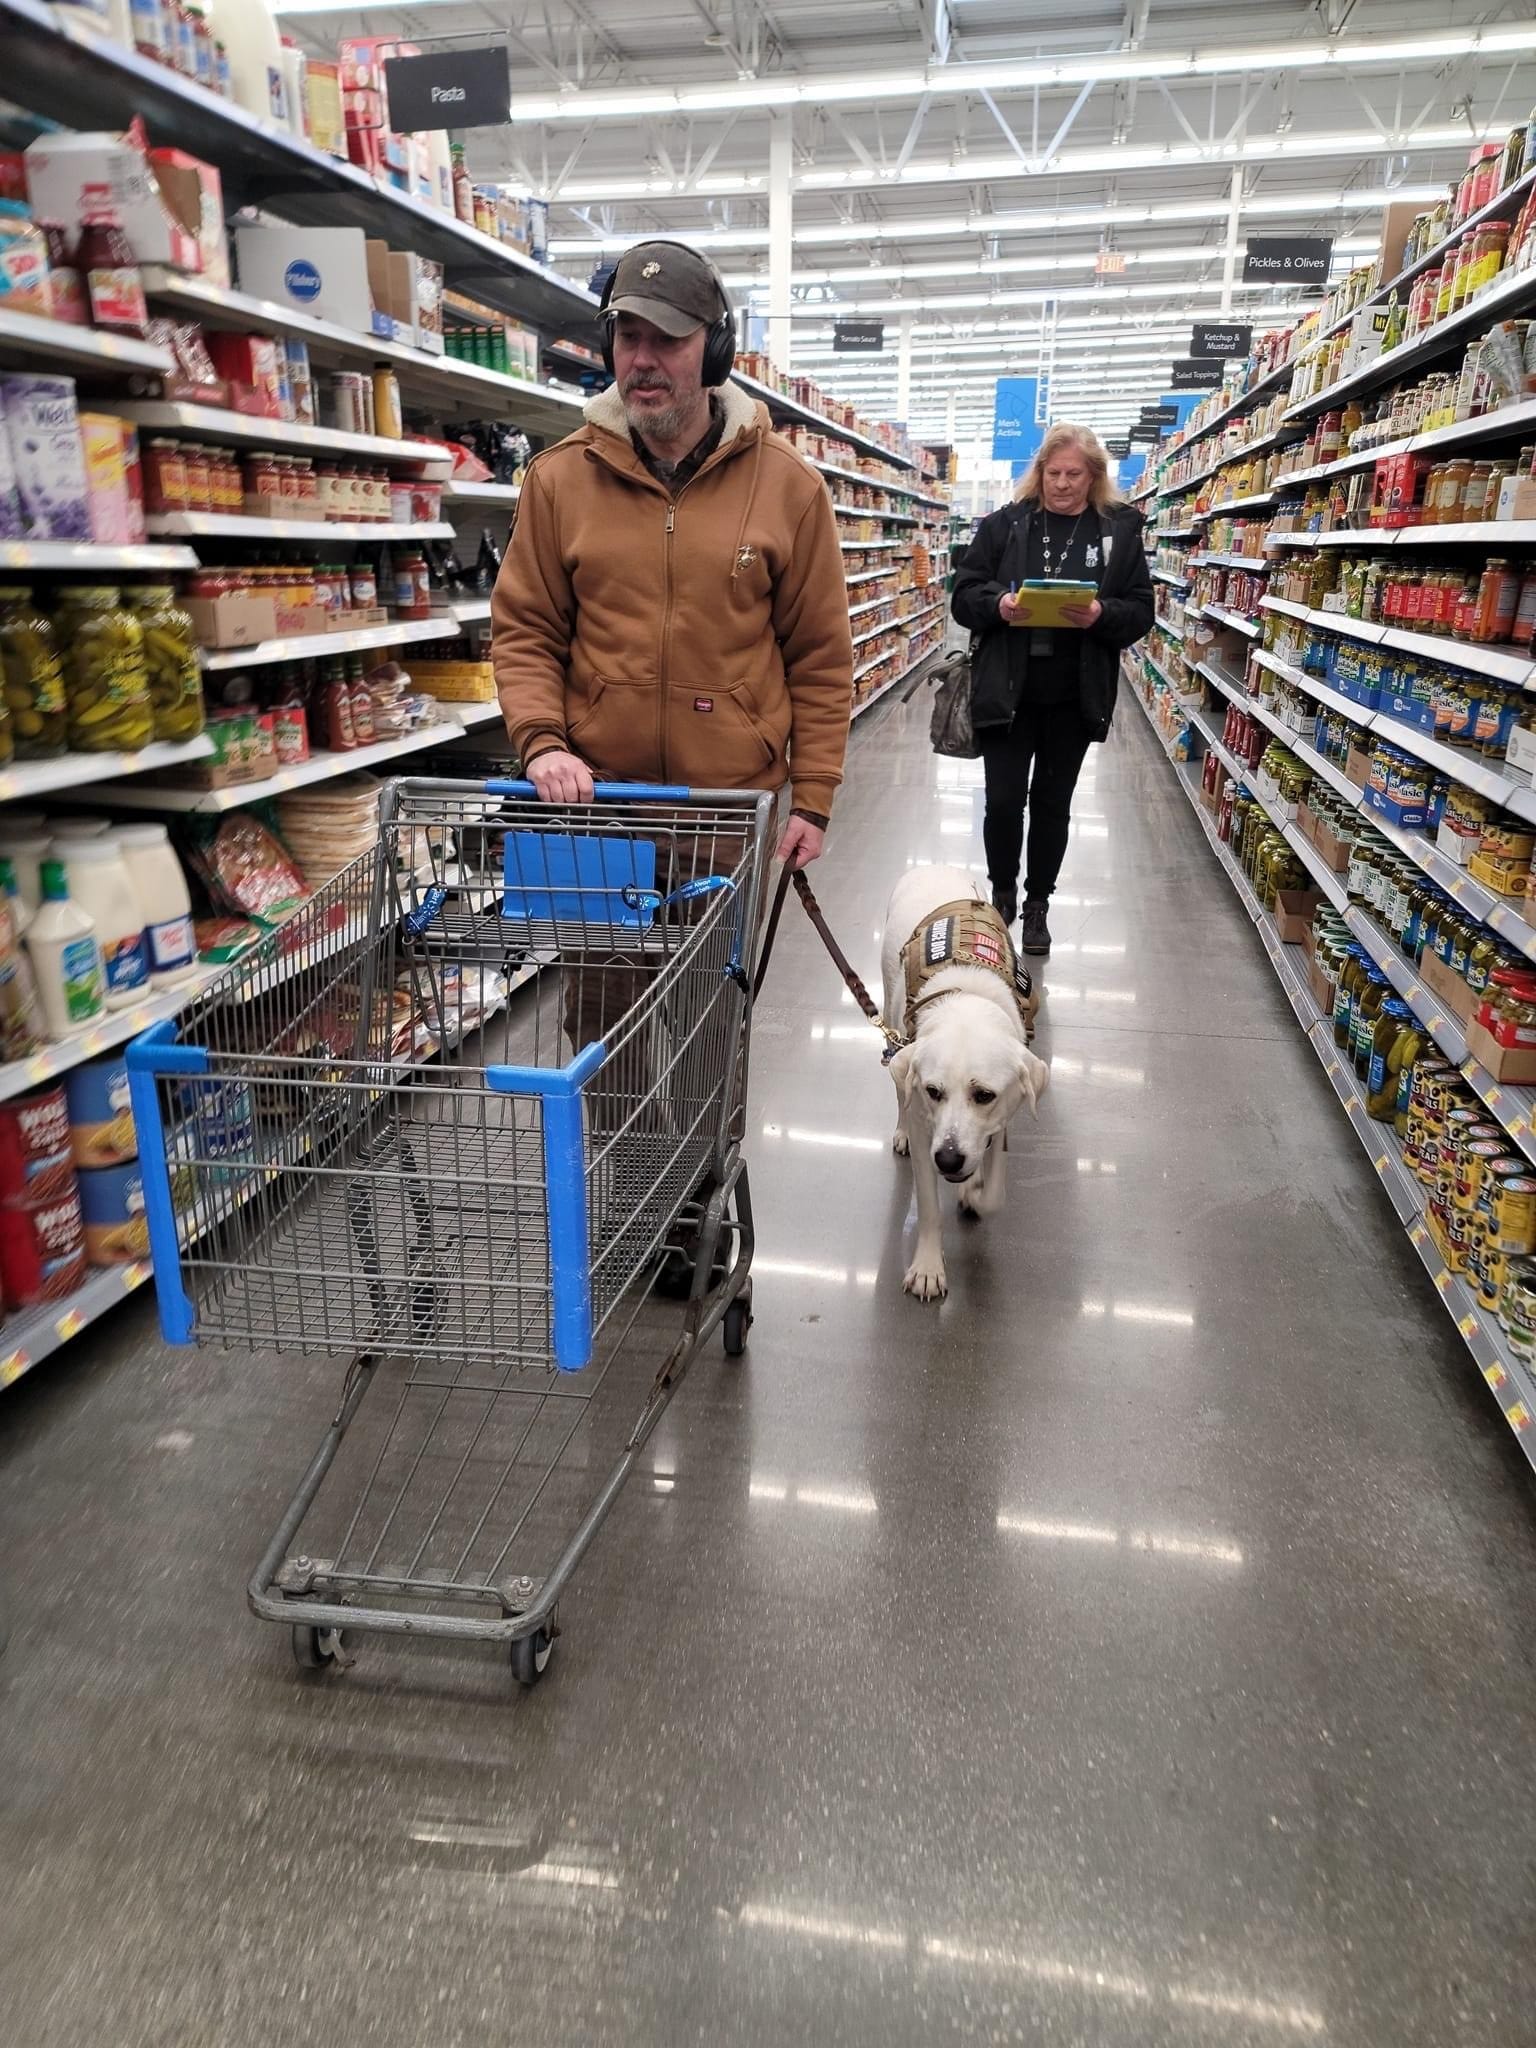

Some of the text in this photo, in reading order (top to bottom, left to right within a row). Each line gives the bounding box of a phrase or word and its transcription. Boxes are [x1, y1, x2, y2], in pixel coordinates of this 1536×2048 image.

[431, 86, 466, 103] Pasta
[1102, 256, 1122, 271] EXIT
[1248, 256, 1325, 268] Pickles & Olives
[840, 335, 860, 343] Tomato
[1204, 333, 1240, 342] Ketchup &
[1206, 342, 1236, 350] Mustard
[1175, 370, 1220, 380] Salad Toppings
[998, 418, 1020, 428] Men's
[996, 428, 1023, 437] Active
[931, 941, 947, 961] DOG
